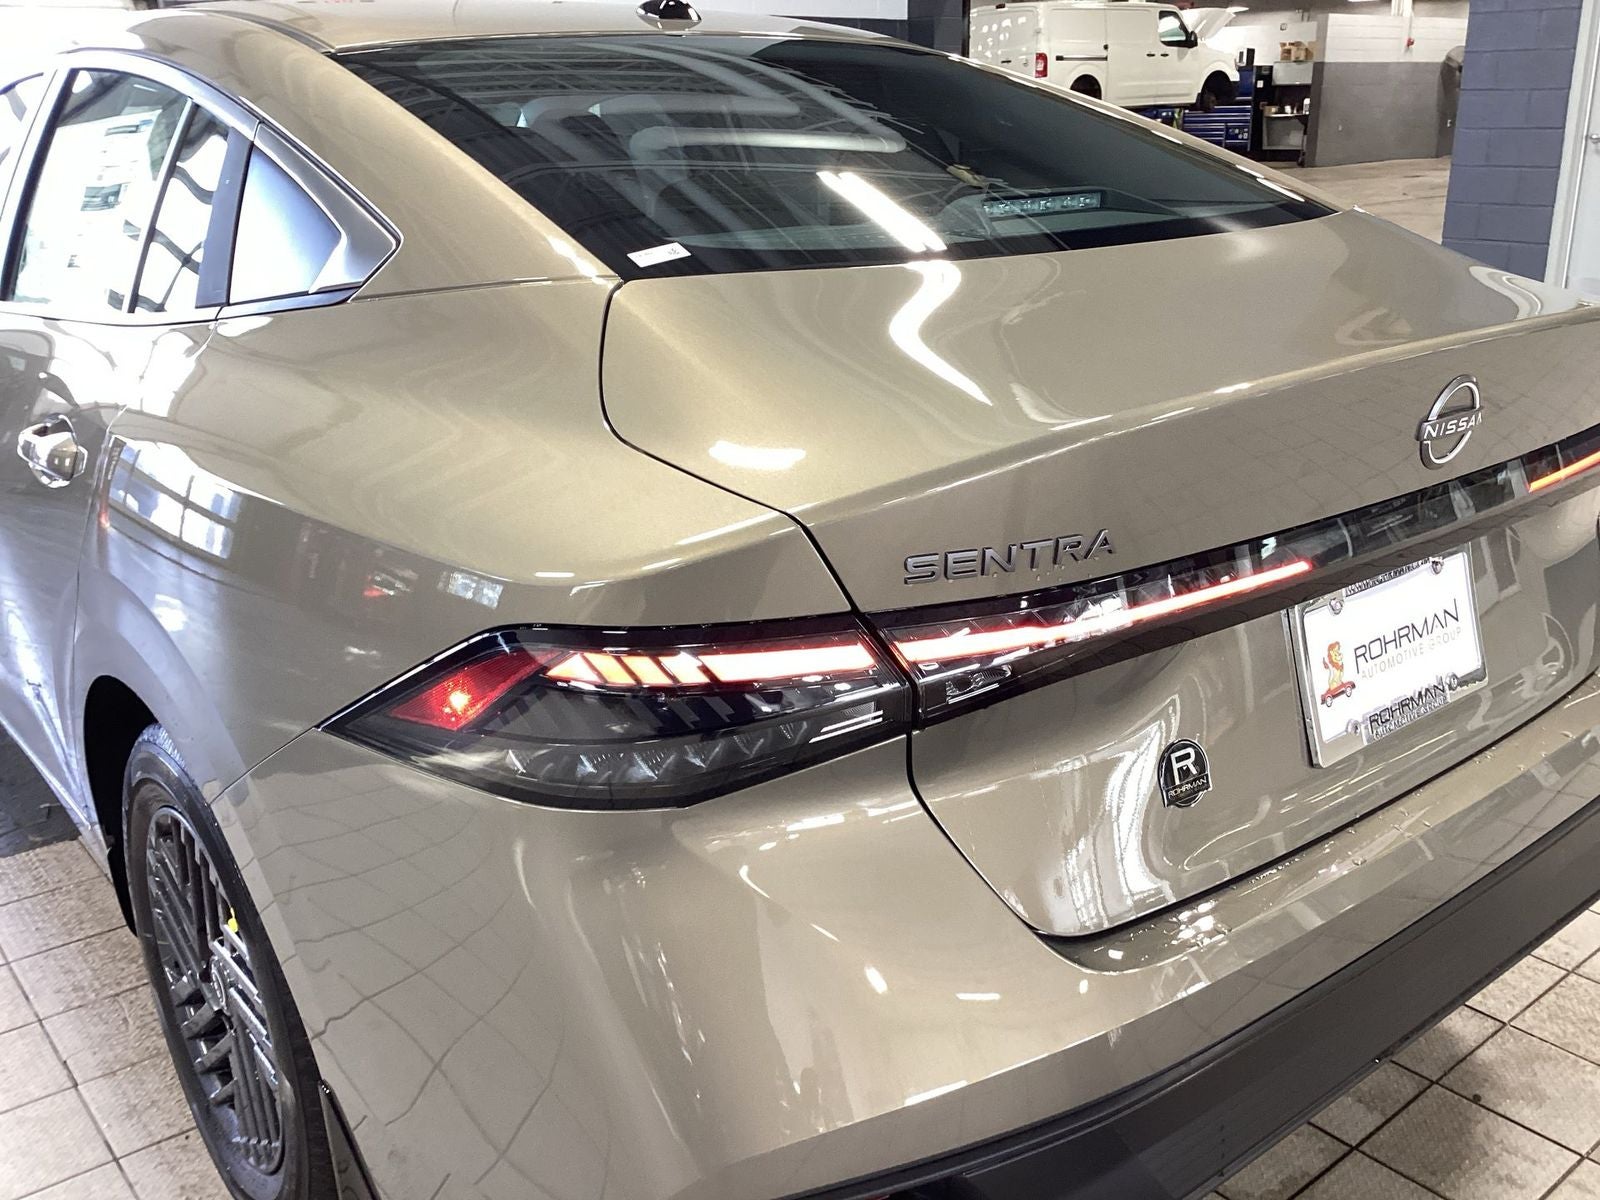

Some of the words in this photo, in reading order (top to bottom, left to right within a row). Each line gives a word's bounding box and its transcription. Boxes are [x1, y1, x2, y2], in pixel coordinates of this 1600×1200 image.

[904, 528, 1115, 585] SENTRA
[1353, 597, 1460, 675] ROHRMAN
[1361, 642, 1425, 679] AUTOMOTIVE
[1428, 626, 1461, 650] GROUP
[1368, 675, 1446, 735] ROHRMAN
[1167, 775, 1207, 799] ROHRMAN
[1170, 747, 1198, 785] R
